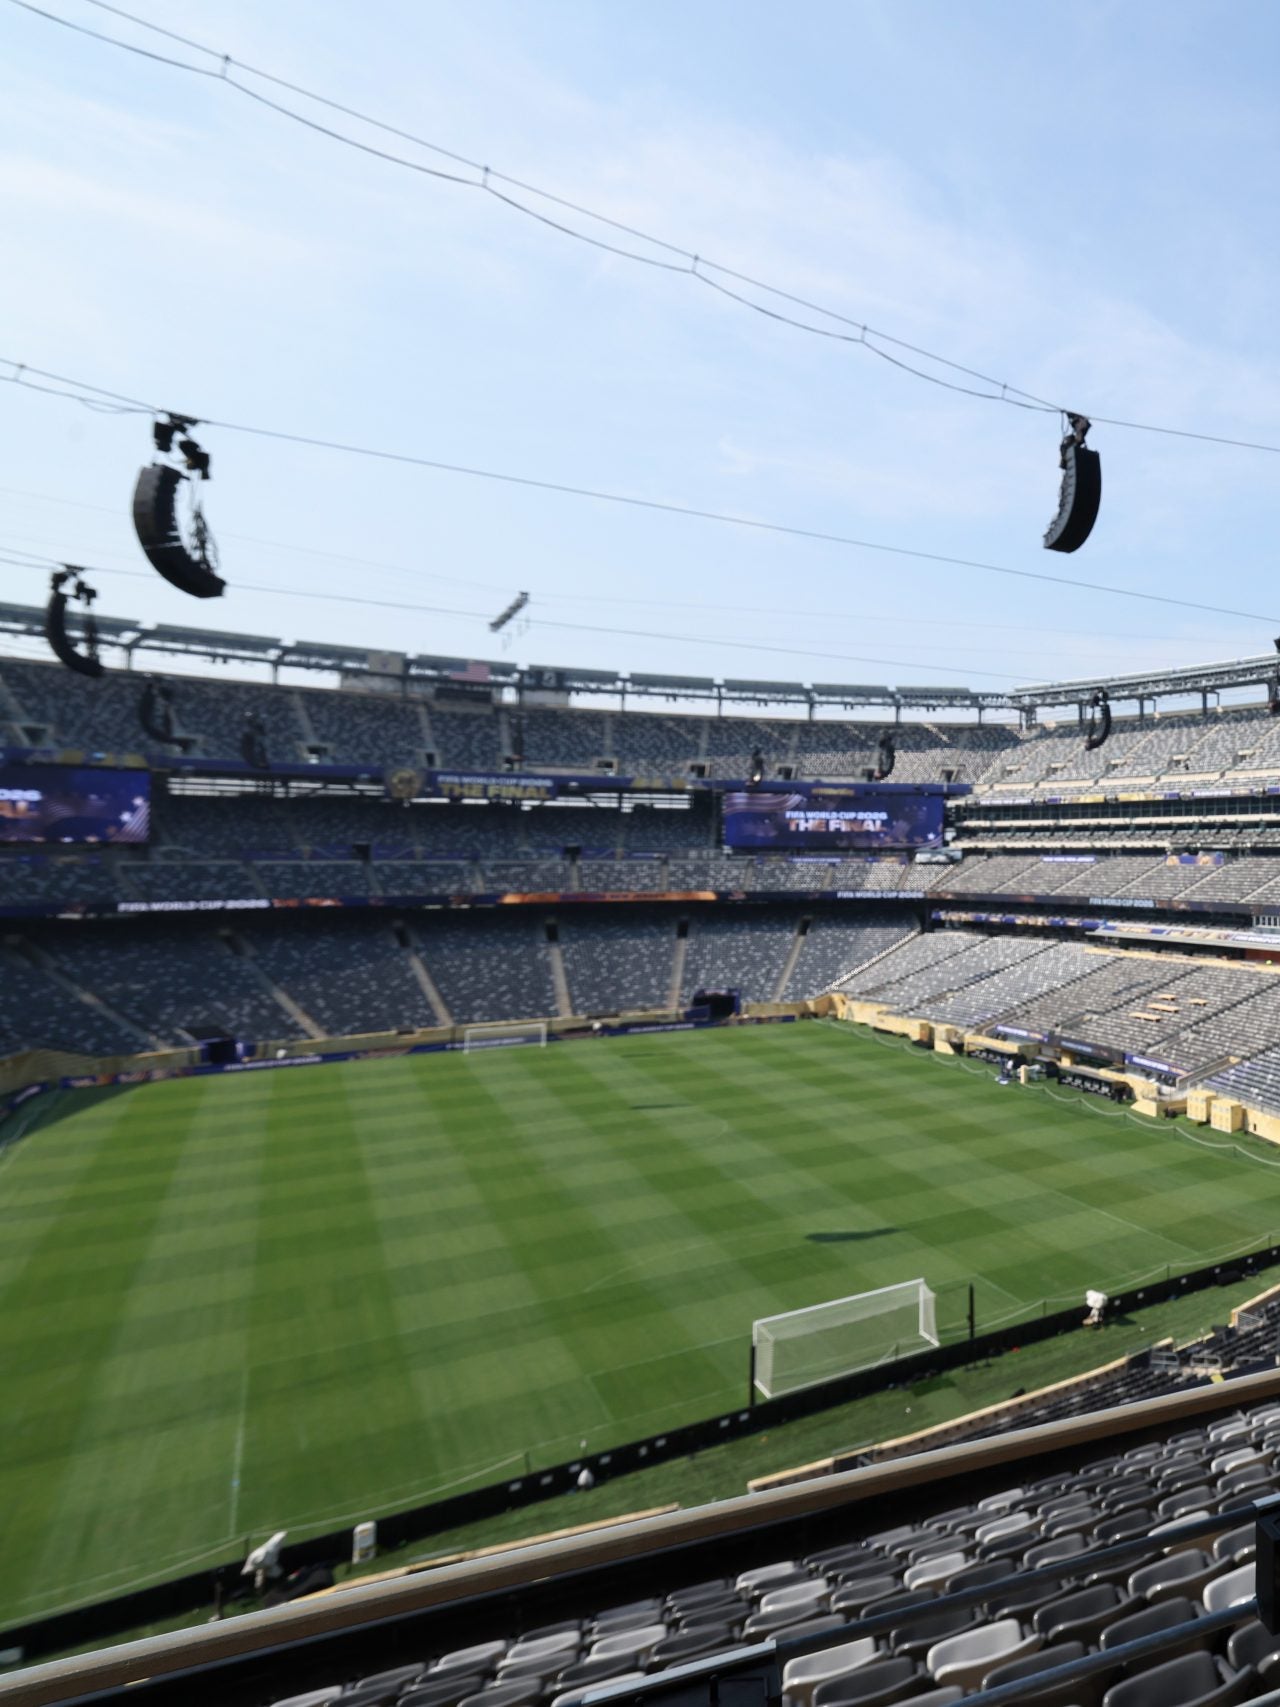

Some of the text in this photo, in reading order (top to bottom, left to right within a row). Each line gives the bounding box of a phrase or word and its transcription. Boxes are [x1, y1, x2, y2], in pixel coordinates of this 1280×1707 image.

[439, 784, 551, 799] THE FINAL
[785, 811, 888, 821] FIFA WORLD CUP 2026
[788, 819, 887, 832] THE FINAL
[882, 890, 898, 899] CUP
